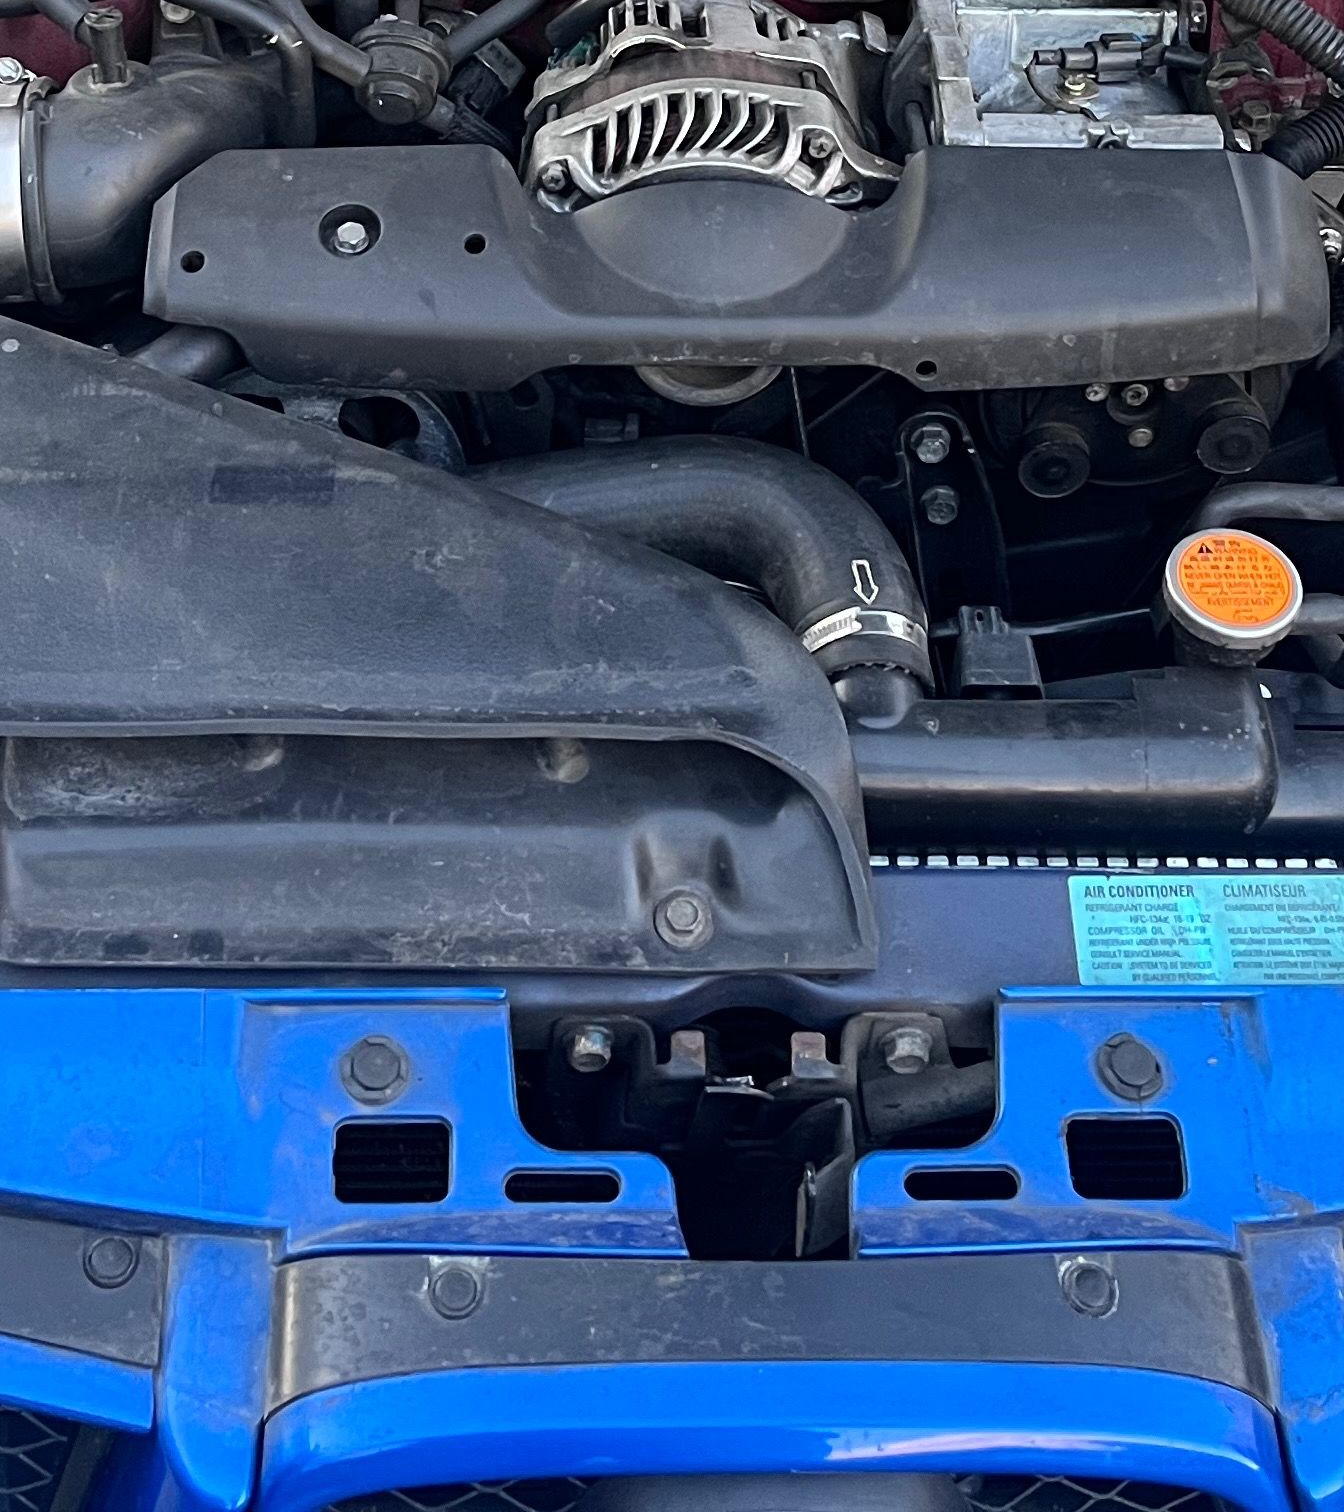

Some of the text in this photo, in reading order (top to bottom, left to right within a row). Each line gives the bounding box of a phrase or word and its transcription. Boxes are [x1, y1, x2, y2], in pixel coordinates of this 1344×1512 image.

[1084, 884, 1195, 899] AIR CONDITIONER
[1223, 884, 1307, 898] CLIMATISEUR
